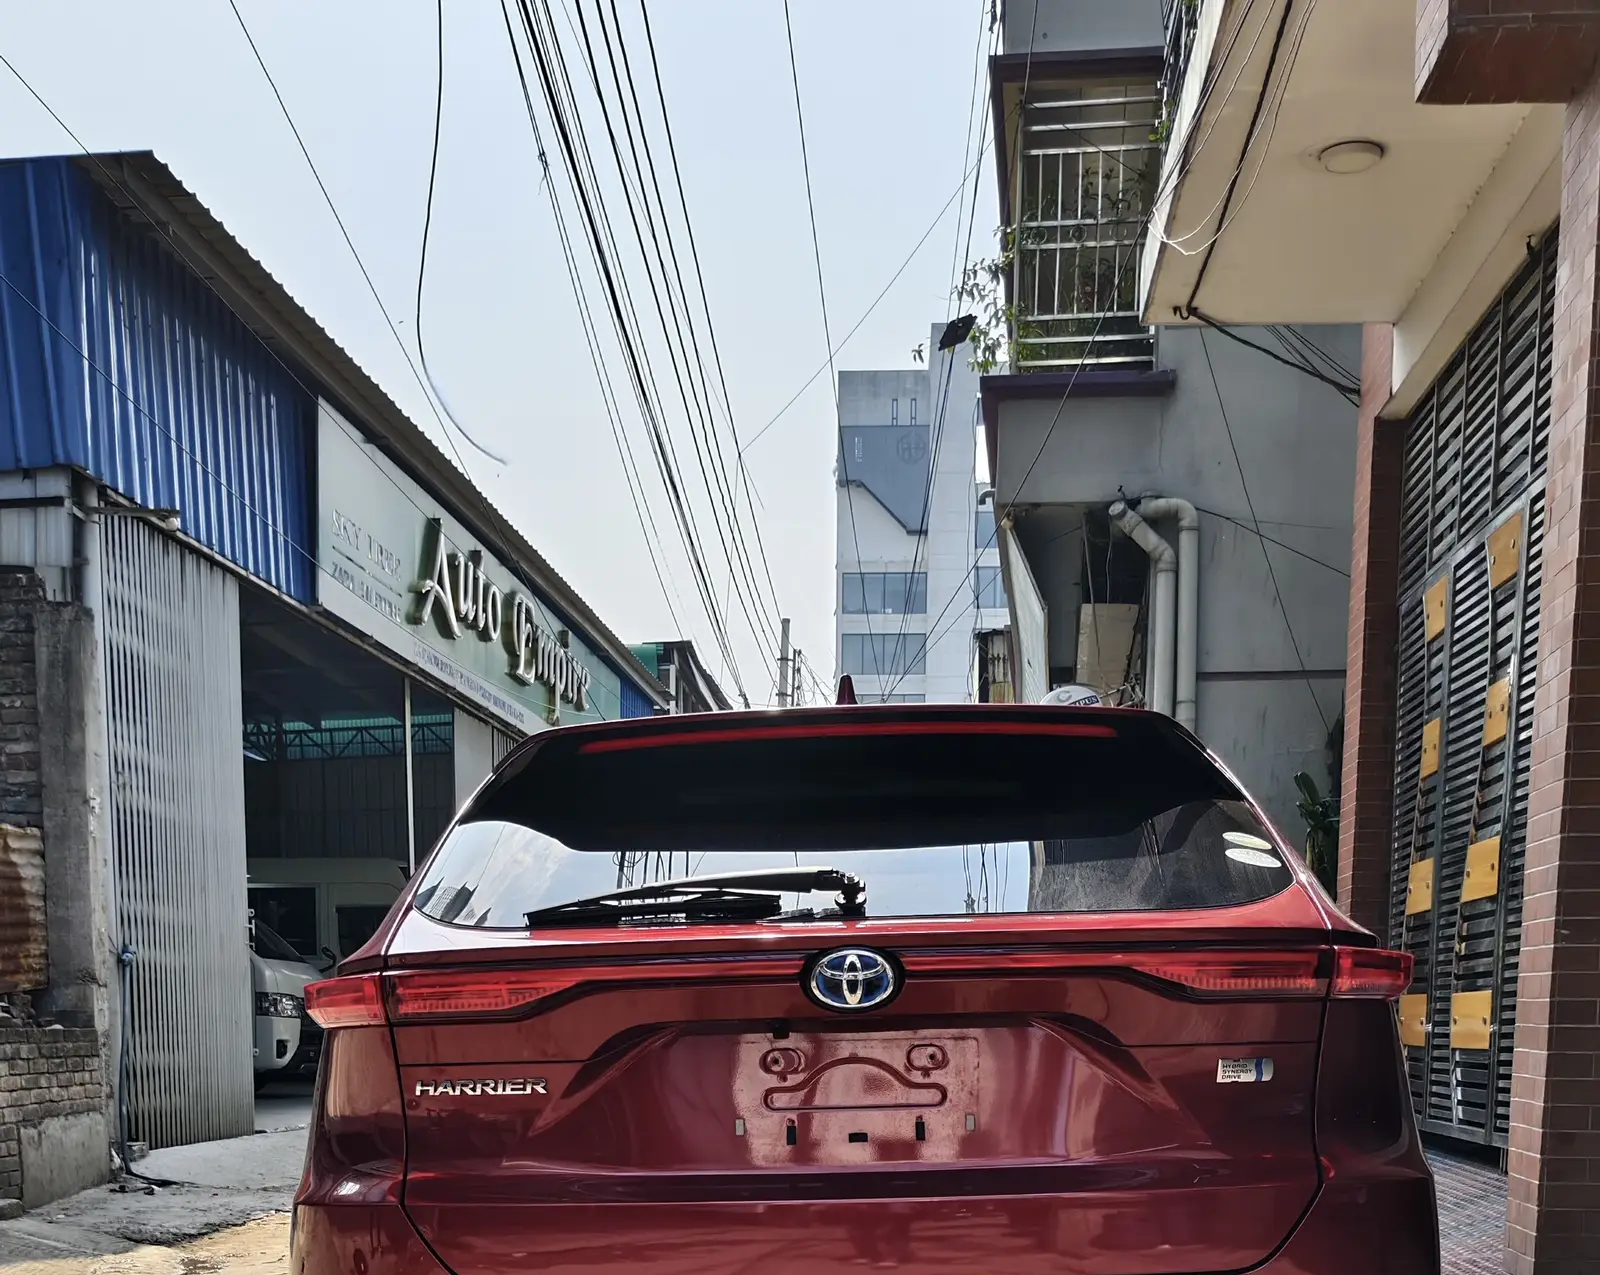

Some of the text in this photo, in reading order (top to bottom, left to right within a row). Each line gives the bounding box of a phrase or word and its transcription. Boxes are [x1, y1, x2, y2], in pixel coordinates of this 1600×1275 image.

[332, 509, 361, 551] SKY
[421, 517, 502, 643] Auto
[512, 592, 591, 723] Empire
[415, 1078, 547, 1096] HARRIER
